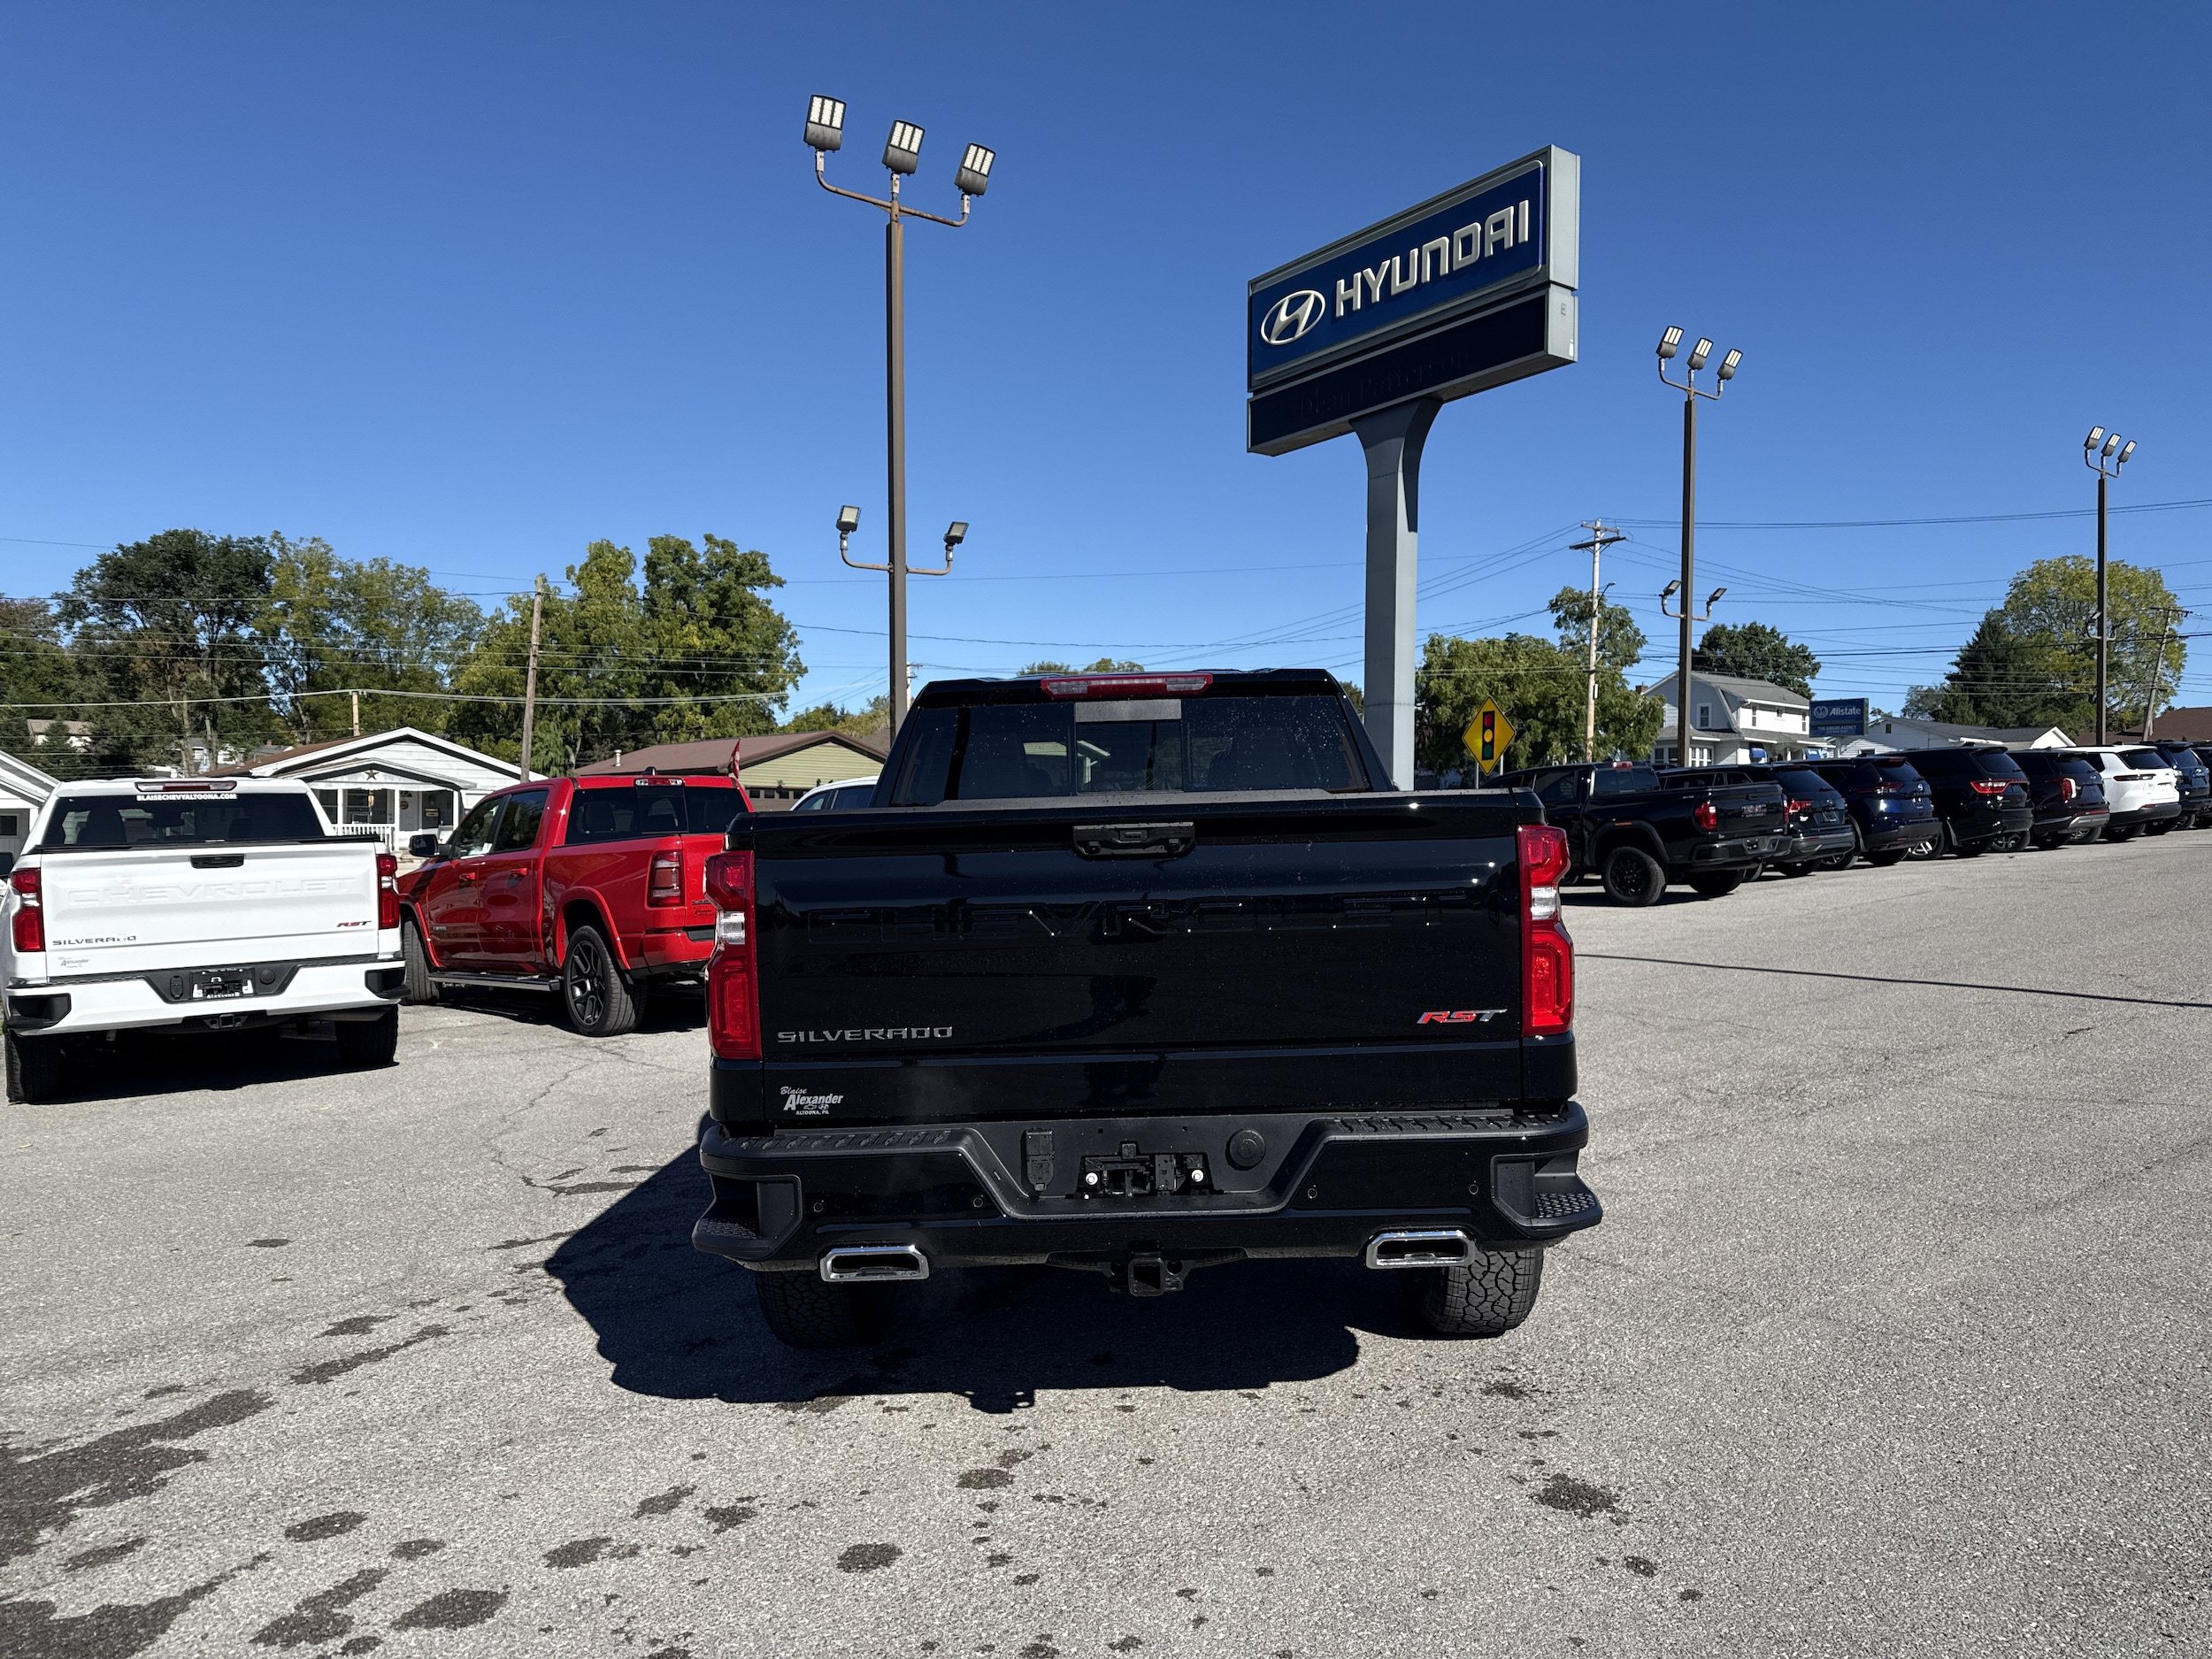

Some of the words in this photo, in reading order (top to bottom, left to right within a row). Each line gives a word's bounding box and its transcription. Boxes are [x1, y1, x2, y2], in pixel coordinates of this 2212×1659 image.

[1335, 199, 1531, 319] HYUNDAI
[1829, 706, 1862, 716] Allstate
[136, 793, 238, 802] BLAISECHEVYALTOONA.COM
[68, 877, 357, 907] CHEVROLET
[1416, 1008, 1508, 1025] RST
[777, 1026, 953, 1044] SILVERADO
[780, 1086, 807, 1095] Blaise
[783, 1093, 844, 1110] Alexander
